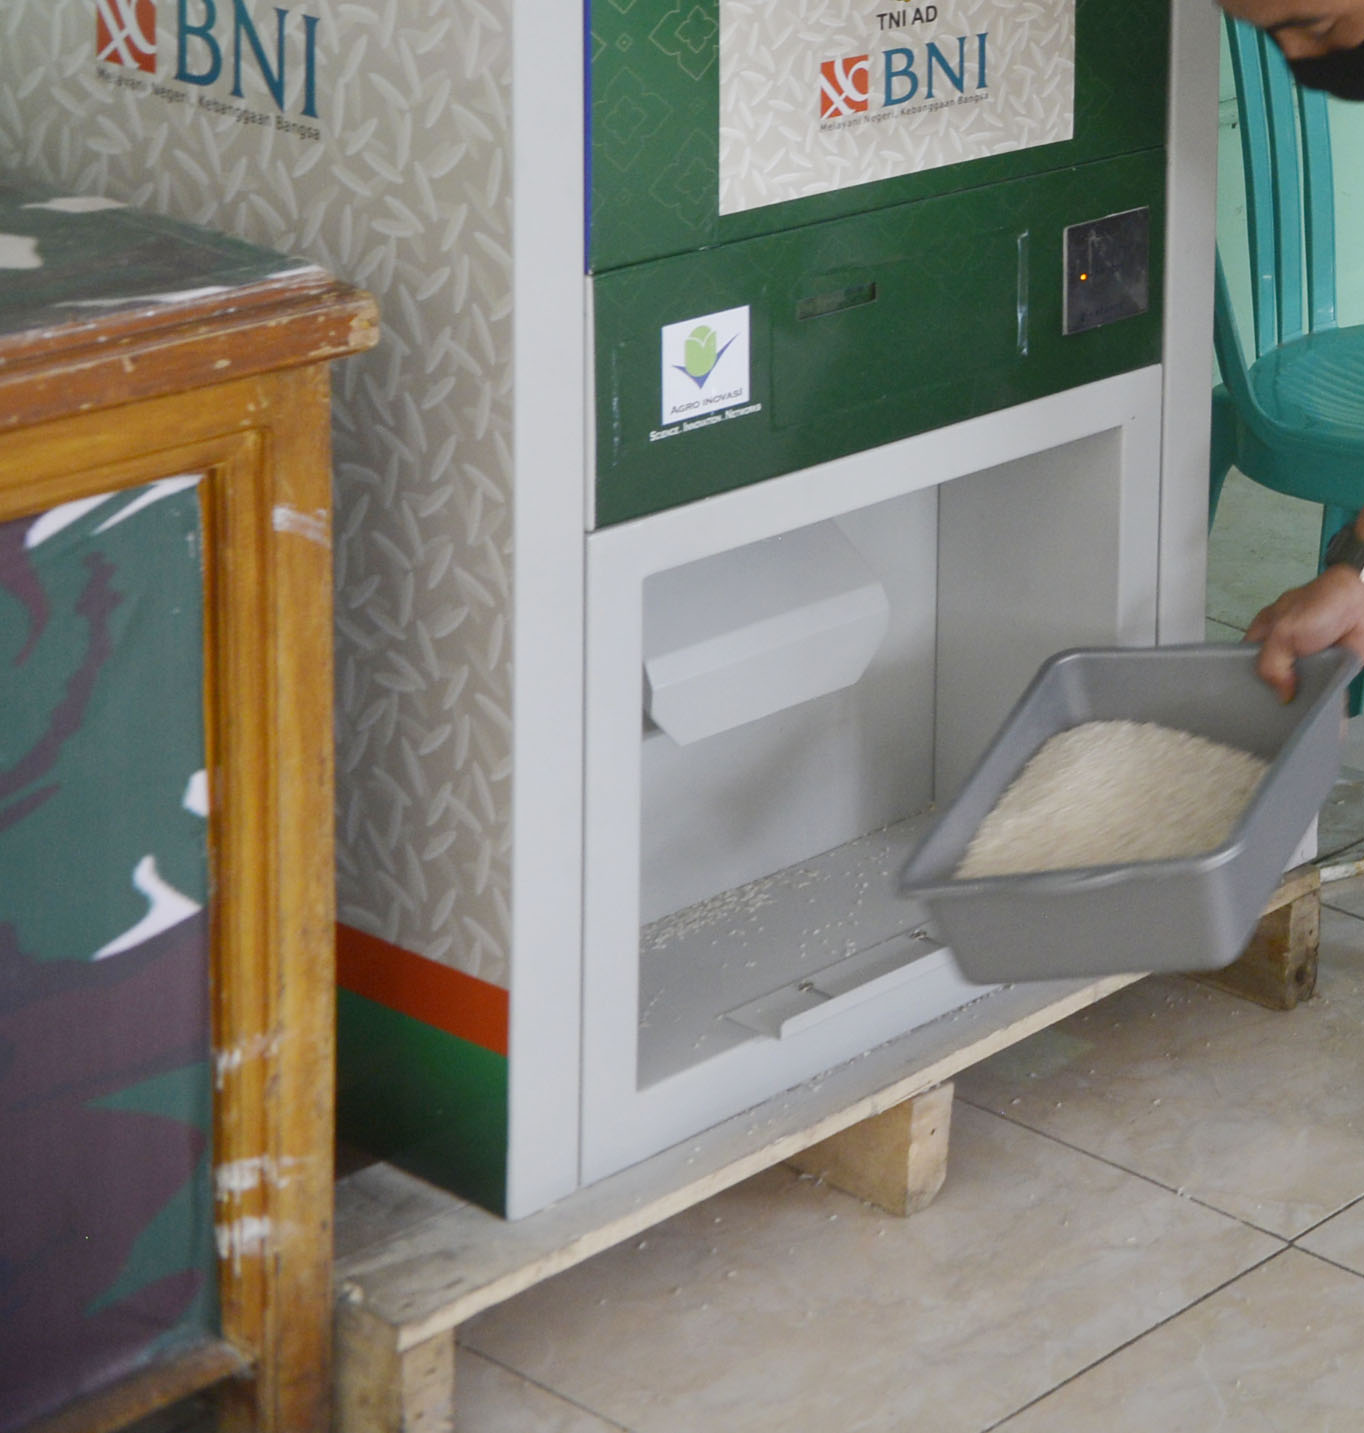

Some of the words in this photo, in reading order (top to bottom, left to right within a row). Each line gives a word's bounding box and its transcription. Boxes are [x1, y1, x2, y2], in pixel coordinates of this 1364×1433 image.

[876, 9, 906, 31] TNI
[912, 5, 938, 25] AD
[882, 32, 989, 108] BNI
[670, 400, 700, 415] AGRO
[702, 388, 743, 406] INOVASI
